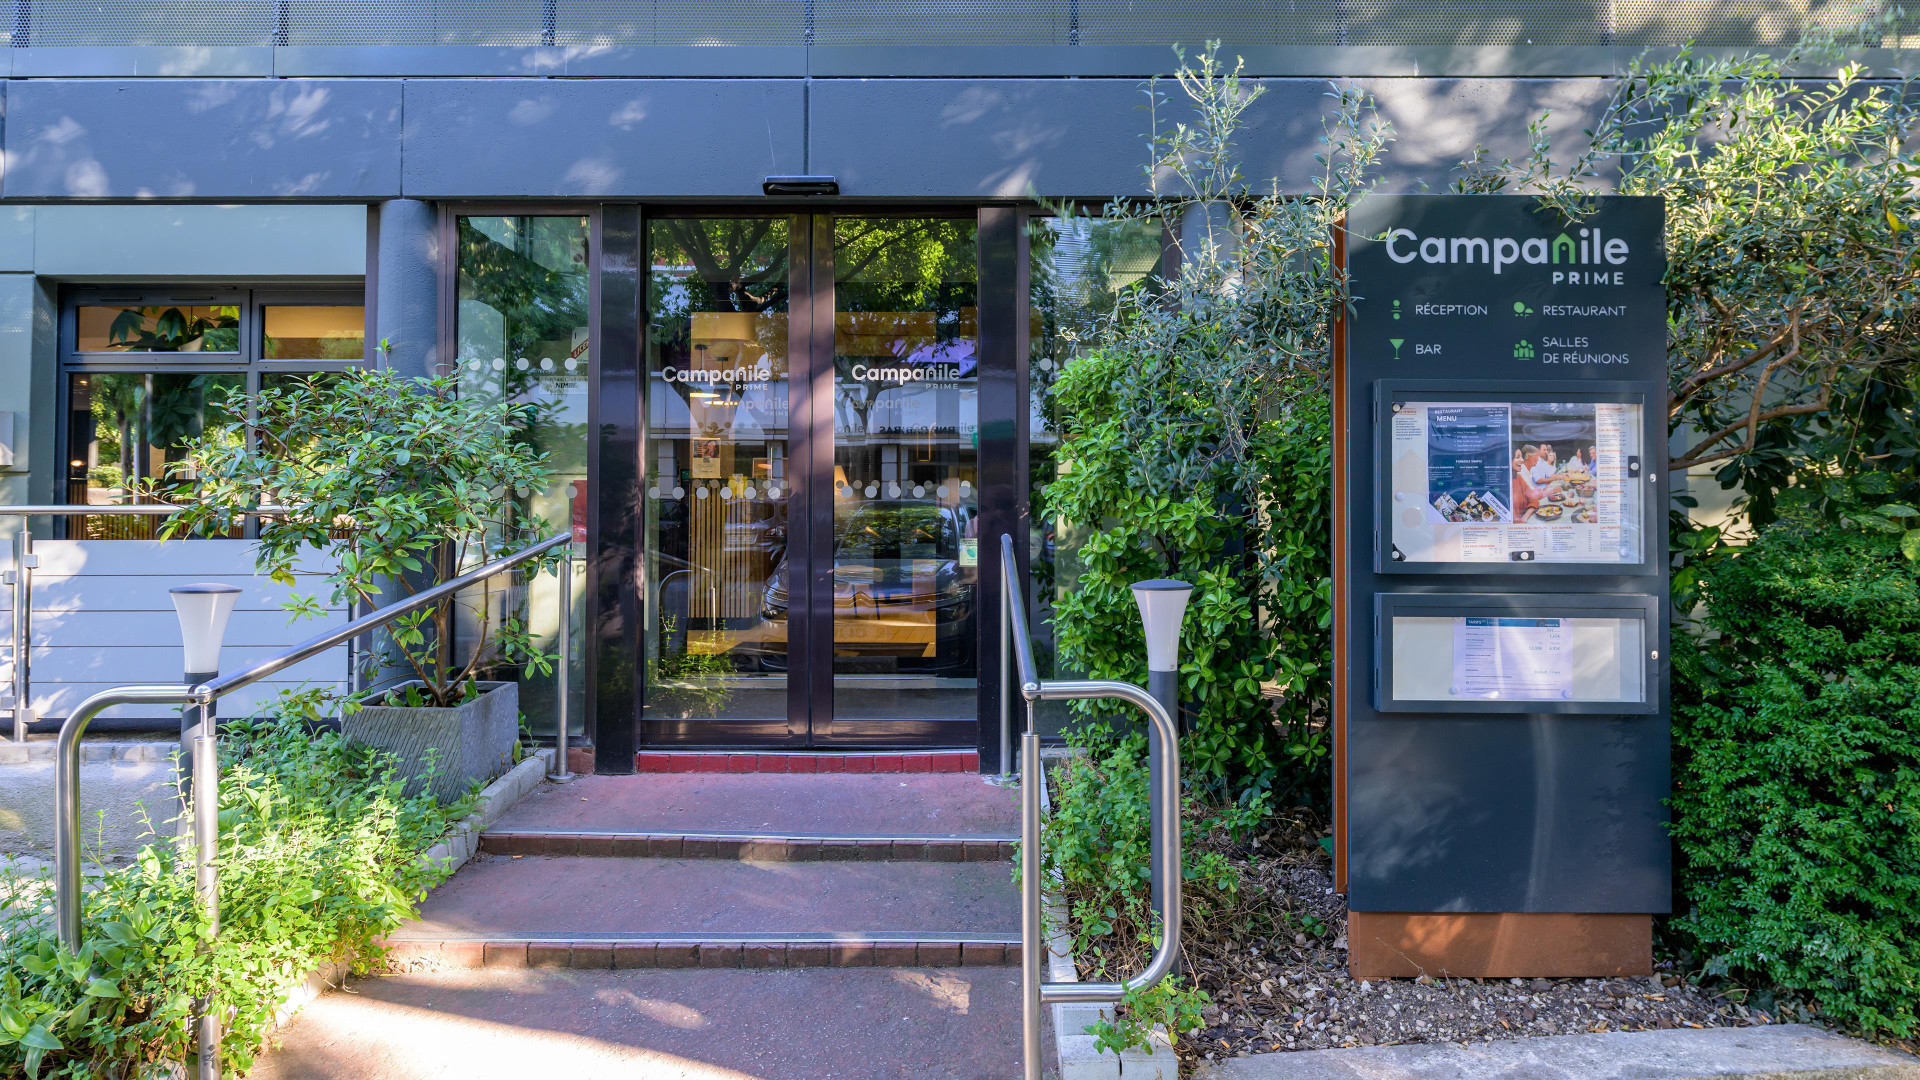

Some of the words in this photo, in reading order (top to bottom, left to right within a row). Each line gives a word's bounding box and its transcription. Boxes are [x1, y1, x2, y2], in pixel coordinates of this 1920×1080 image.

[1385, 227, 1630, 275] Campanile
[1552, 271, 1625, 286] PRIME
[1415, 302, 1488, 315] RÉCEPTION
[1543, 305, 1627, 316] RESTAURANT
[1542, 336, 1589, 348] SALLES
[1415, 344, 1442, 355] BAR
[1543, 353, 1560, 364] DE
[1563, 350, 1629, 364] RÉUNIONS
[662, 364, 771, 386] Campanile
[851, 363, 960, 386] Campanile
